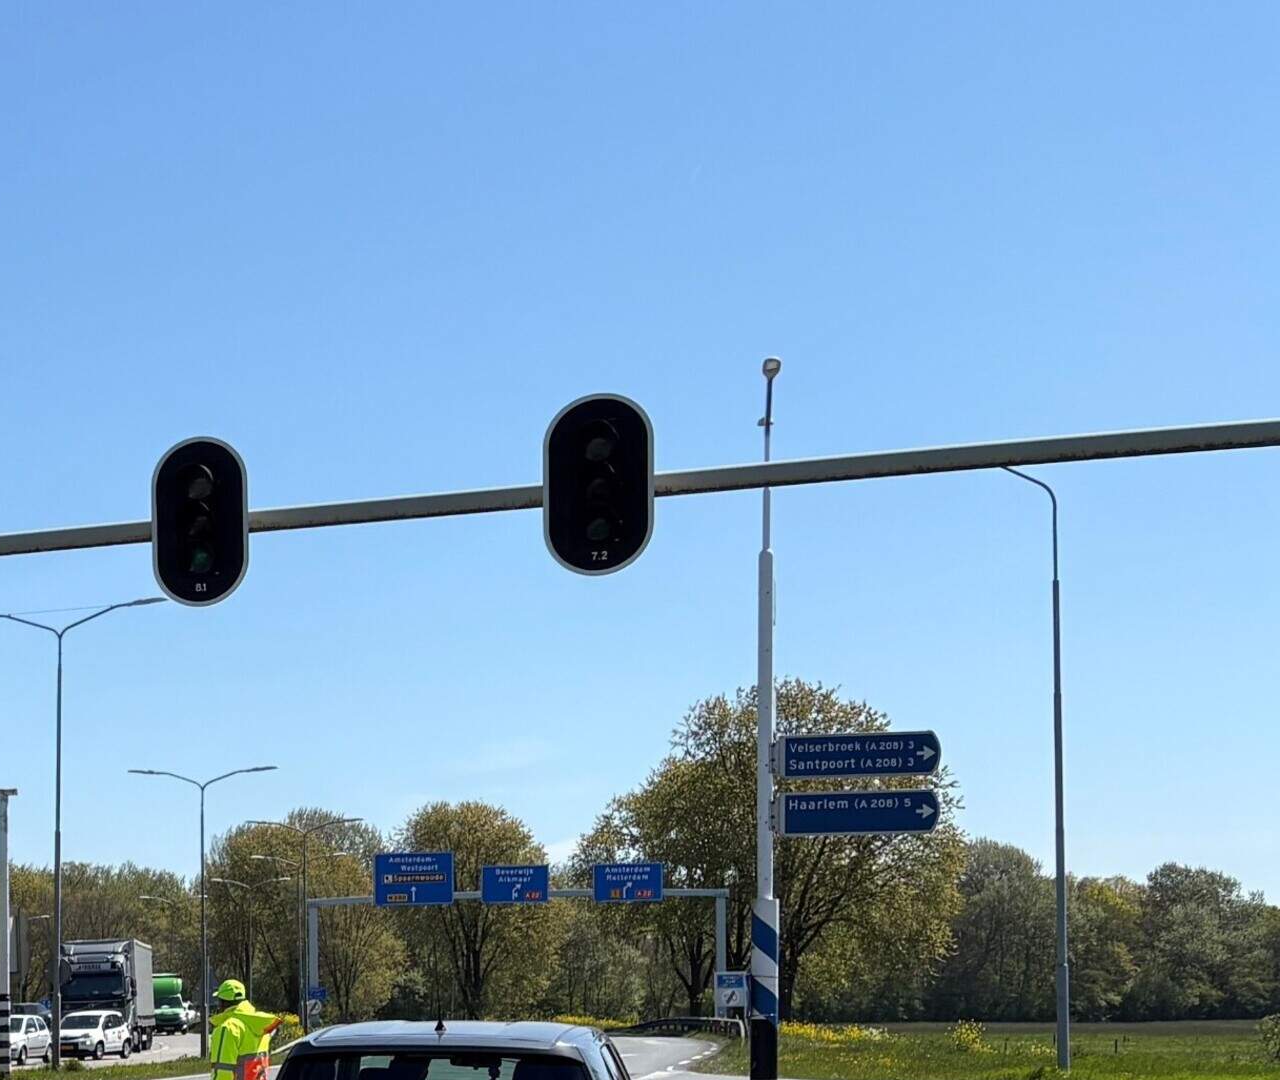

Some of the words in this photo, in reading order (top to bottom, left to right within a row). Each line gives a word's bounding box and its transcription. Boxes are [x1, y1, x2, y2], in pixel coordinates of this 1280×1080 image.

[591, 550, 608, 560] 7.2
[789, 741, 861, 753] Velserbroek
[908, 740, 915, 749] 3
[789, 757, 856, 771] Santpoort
[907, 757, 915, 767] 3
[789, 798, 849, 810] Haarlem
[904, 797, 912, 807] 5
